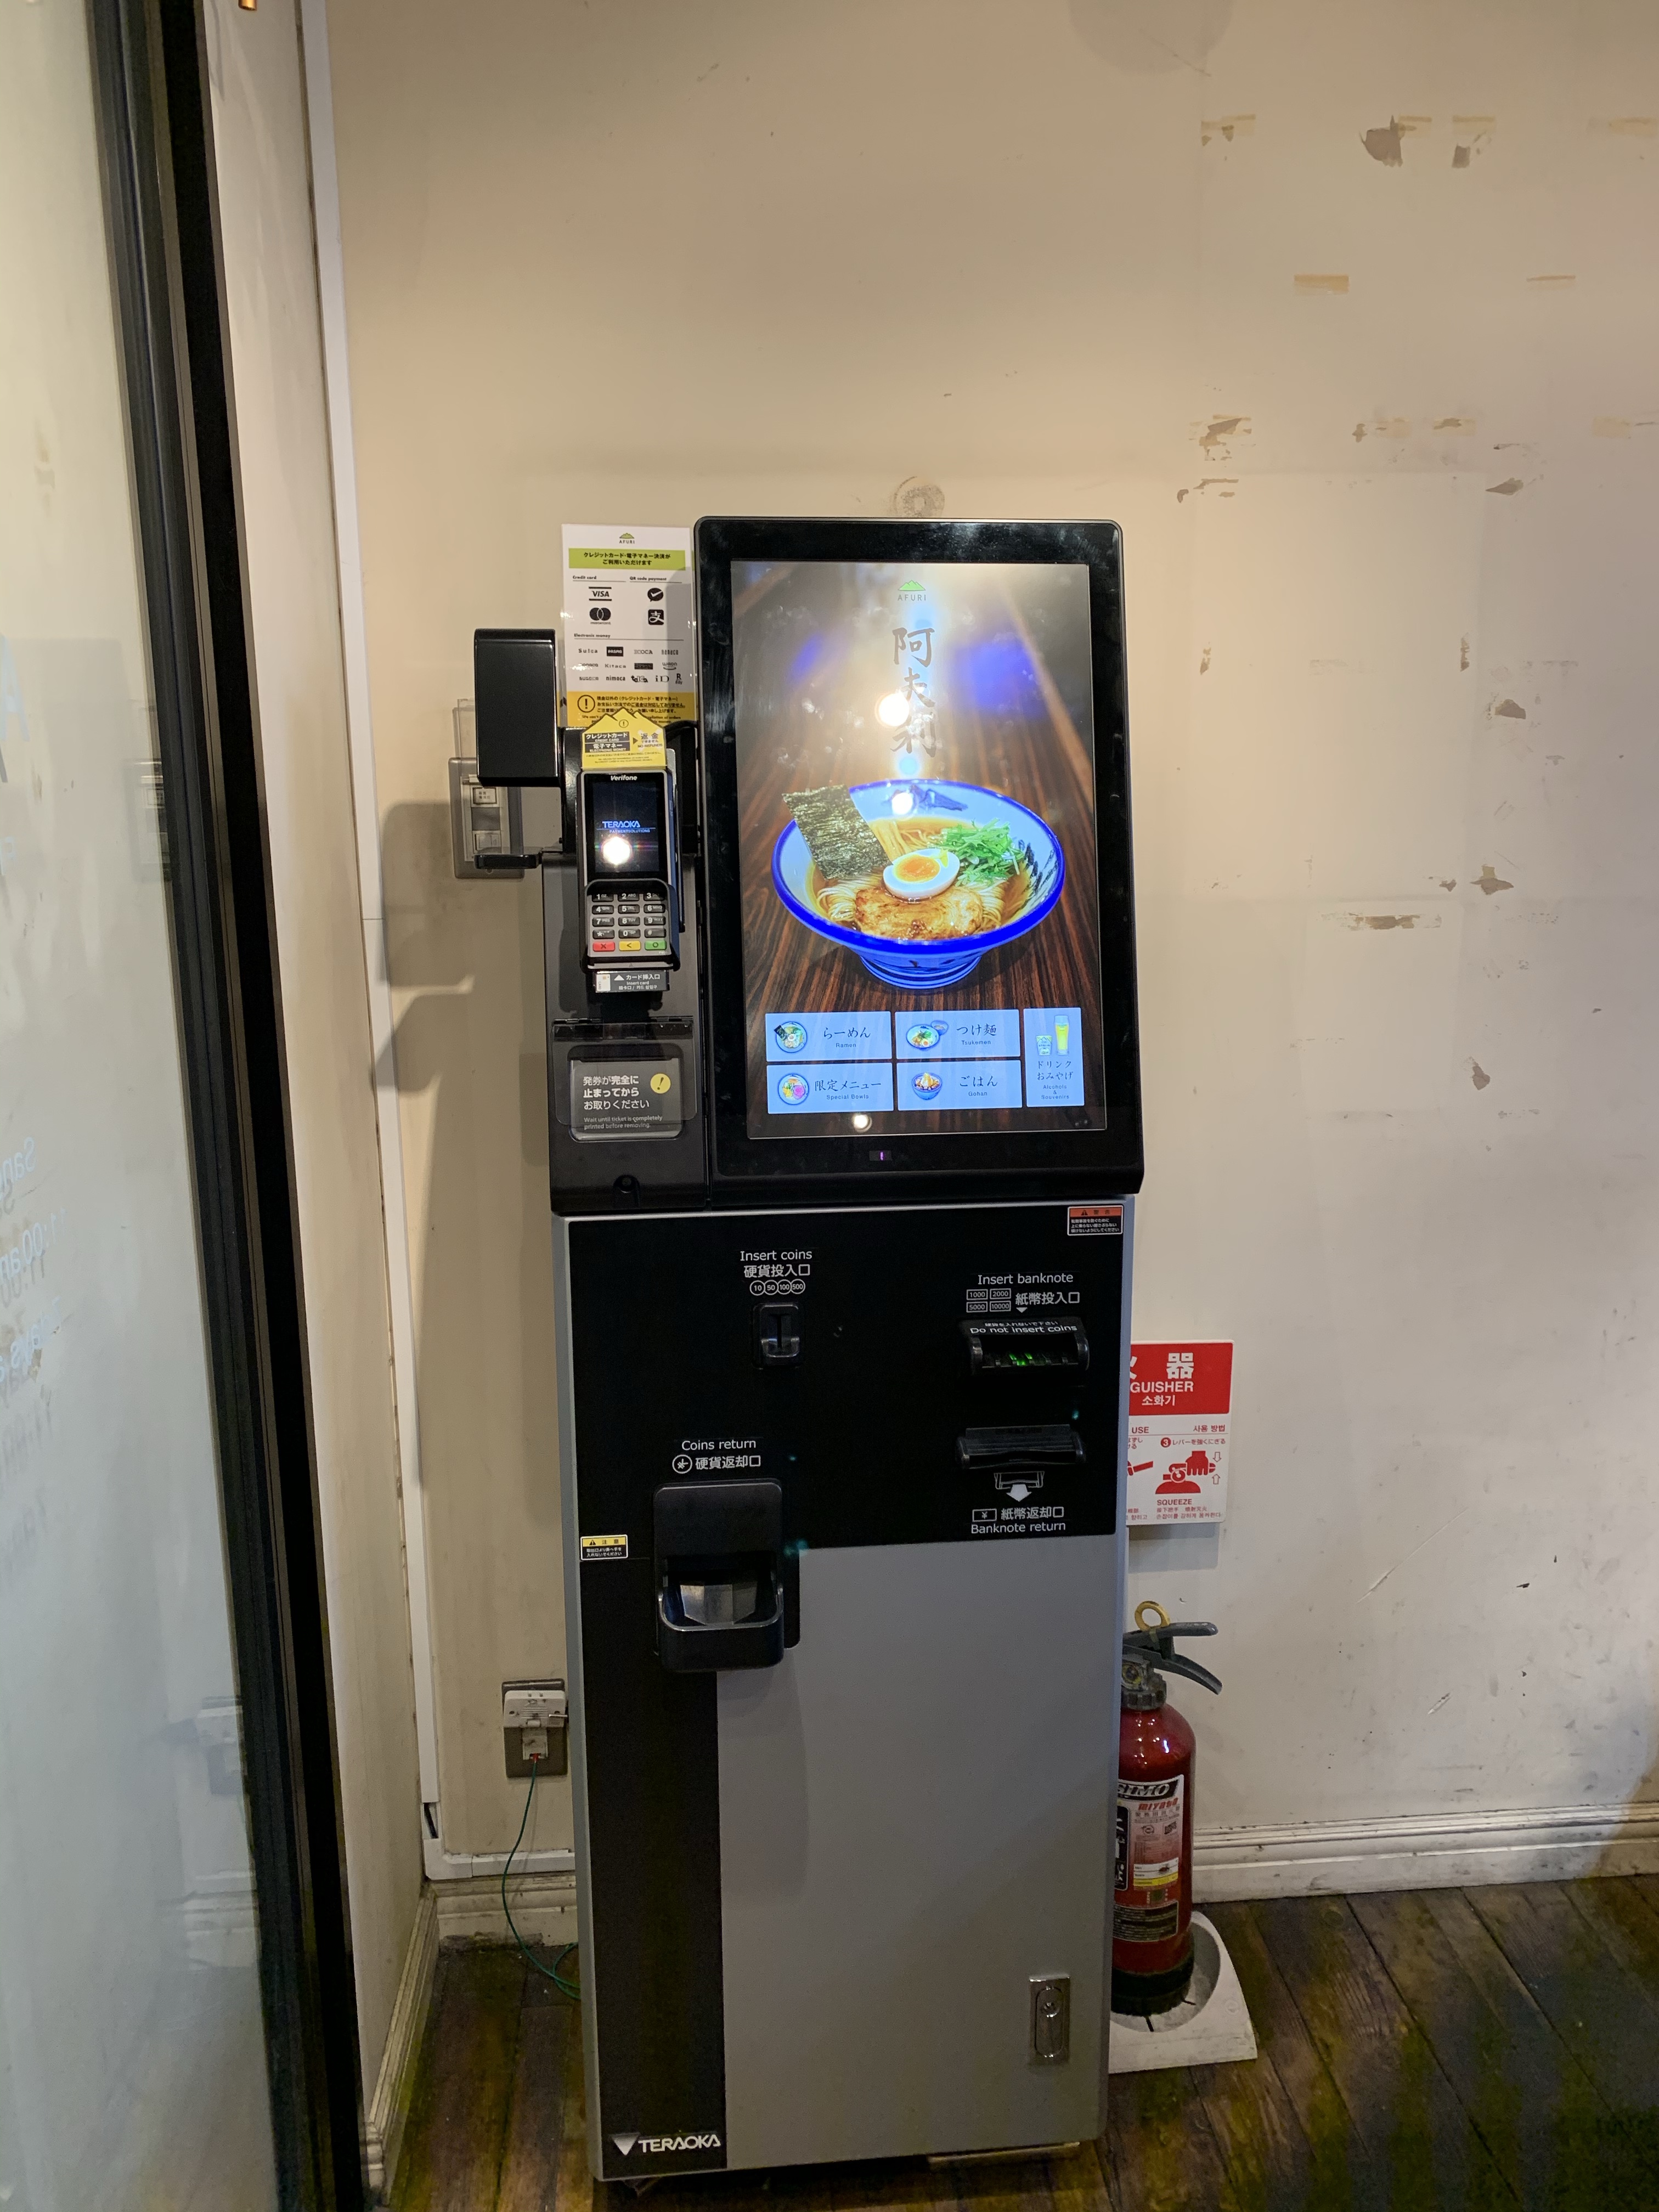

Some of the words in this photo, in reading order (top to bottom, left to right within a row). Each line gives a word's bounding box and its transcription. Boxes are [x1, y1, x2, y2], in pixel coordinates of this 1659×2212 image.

[823, 1027, 871, 1039] らーめん
[956, 1024, 997, 1036] つけ麺
[1037, 1060, 1071, 1069] ドリンク
[583, 1075, 639, 1086] 発券が完全に
[960, 1075, 998, 1087] ごはん
[1037, 1071, 1074, 1081] おみやげ
[815, 1080, 881, 1091] 限定メニュー
[583, 1087, 639, 1098] 止まってから
[584, 1100, 650, 1110] お取りください
[740, 1250, 777, 1261] Insert
[781, 1249, 812, 1260] coins
[744, 1264, 810, 1278] 硬貨投入口
[978, 1274, 1013, 1285] Insert
[1018, 1273, 1073, 1284] banknote
[1015, 1291, 1080, 1306] 紙幣投入口
[1142, 1395, 1176, 1406] 소화기
[682, 1440, 714, 1451] Coins
[719, 1440, 756, 1449] return
[696, 1455, 761, 1470] 硬貨返却口
[1001, 1506, 1064, 1520] 紙幣返却口
[972, 1523, 1025, 1533] Banknote
[1030, 1522, 1065, 1532] return
[638, 2135, 721, 2153] TERAOKA
